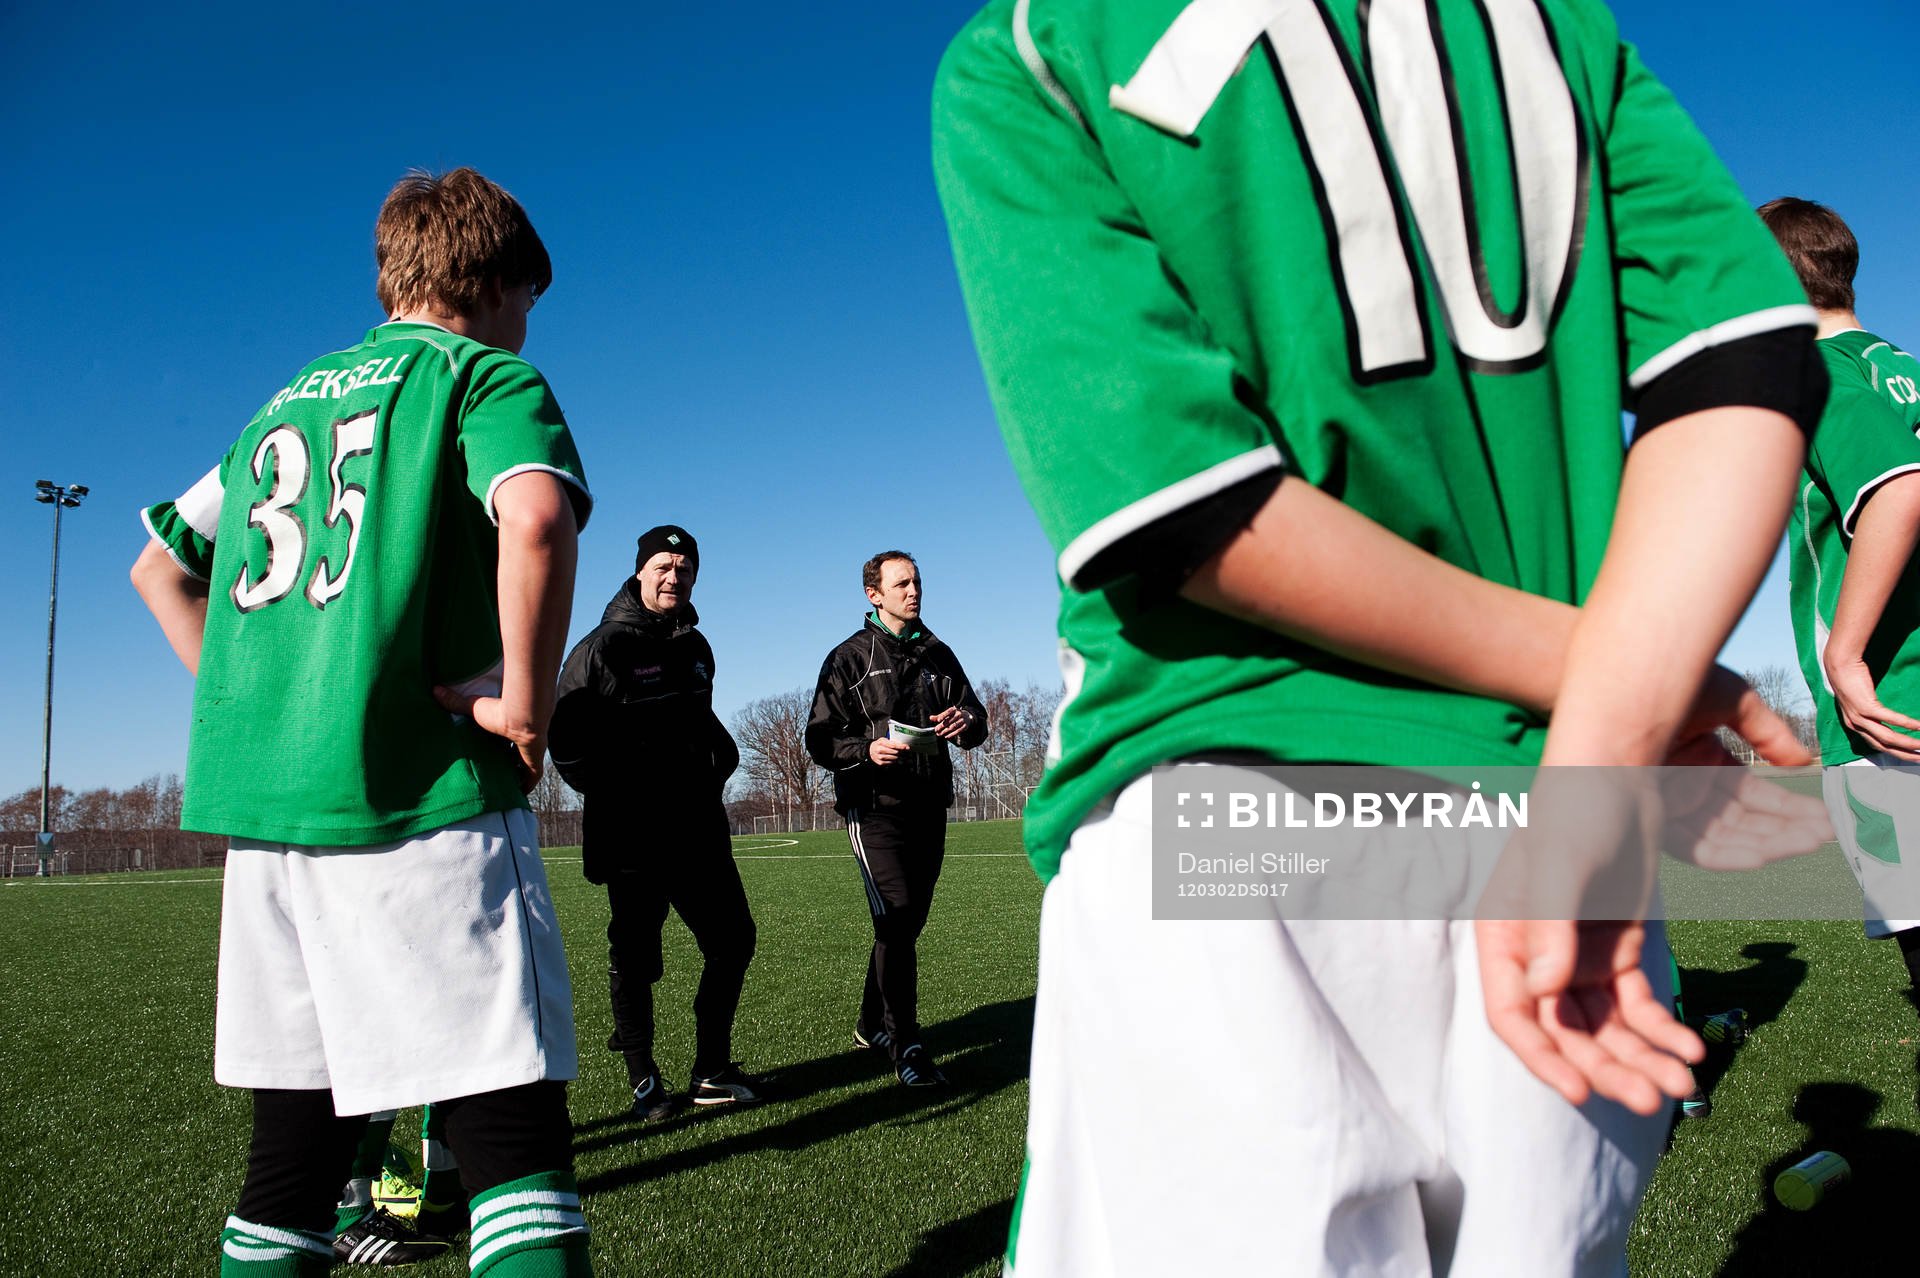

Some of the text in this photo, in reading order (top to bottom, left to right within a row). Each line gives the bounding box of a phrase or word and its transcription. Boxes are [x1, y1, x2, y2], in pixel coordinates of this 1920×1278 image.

[1109, 0, 1592, 386] 10
[267, 354, 410, 416] ALEKSELL
[231, 405, 379, 614] 35
